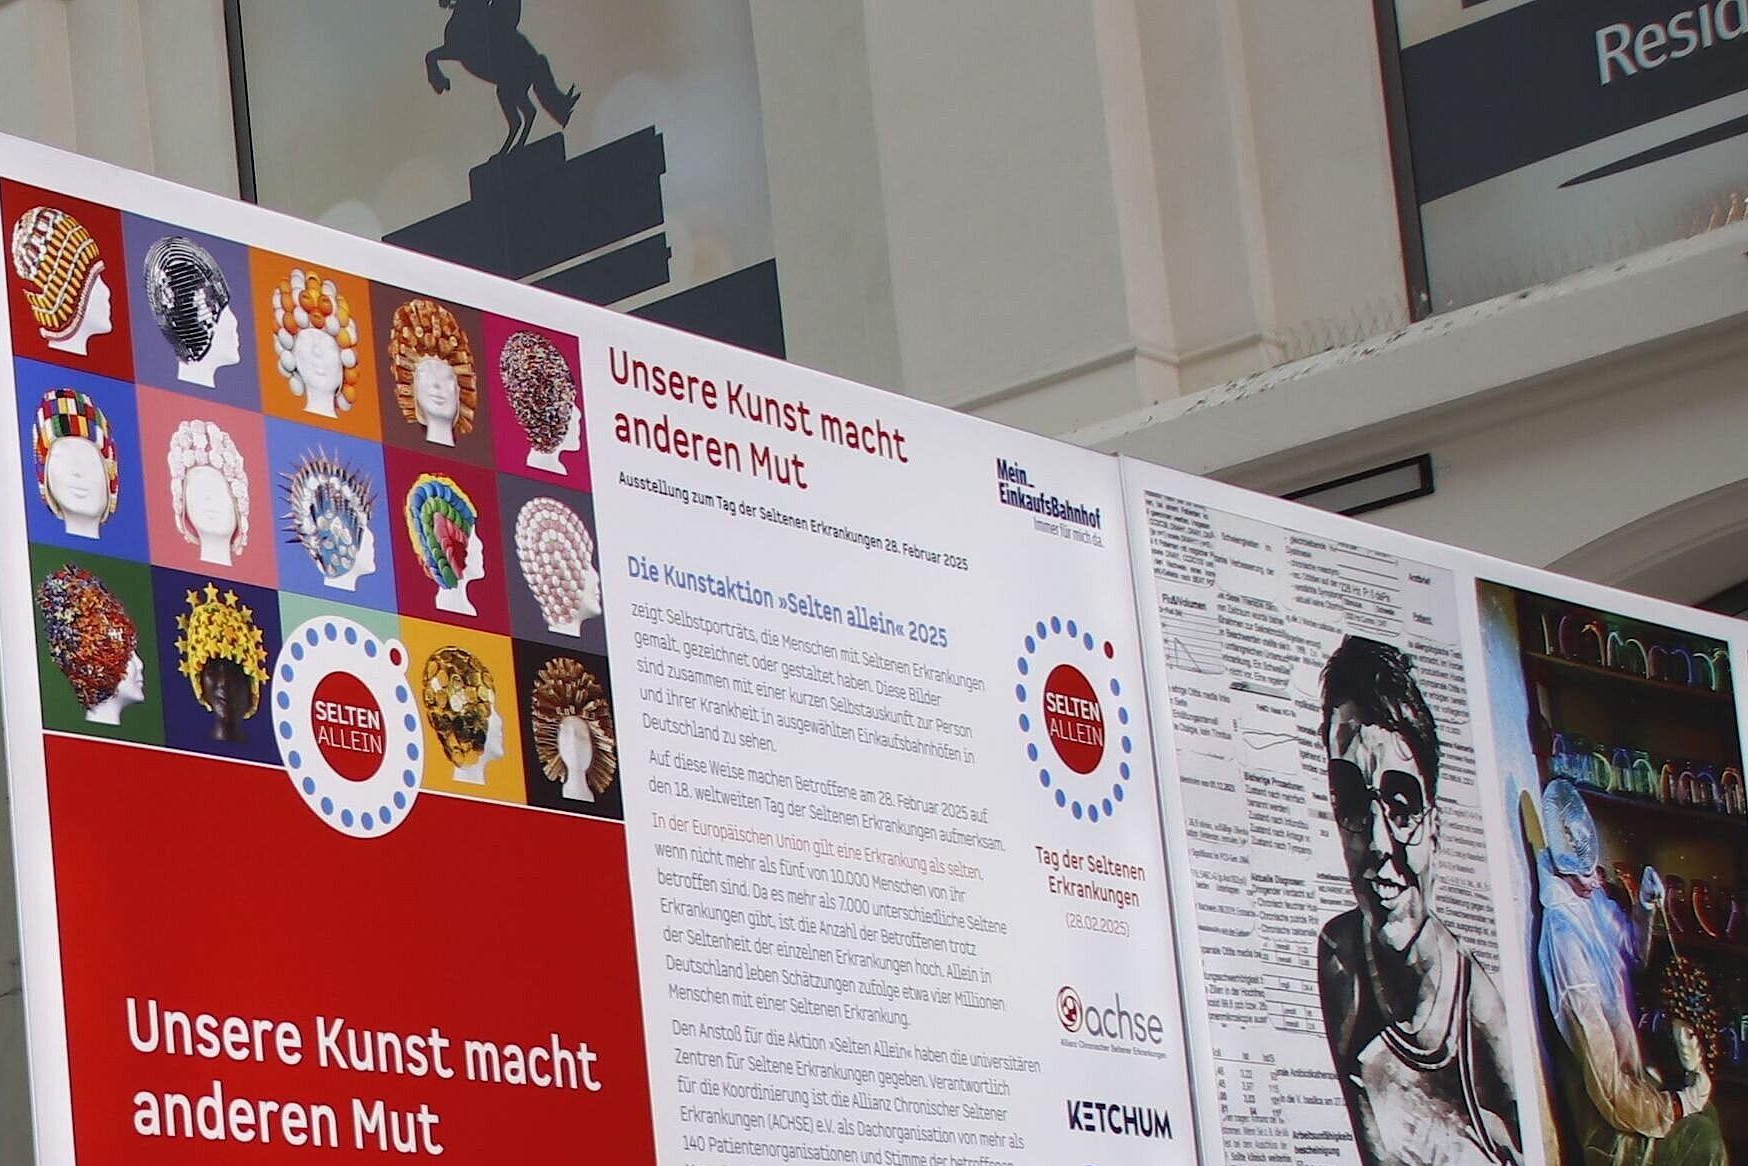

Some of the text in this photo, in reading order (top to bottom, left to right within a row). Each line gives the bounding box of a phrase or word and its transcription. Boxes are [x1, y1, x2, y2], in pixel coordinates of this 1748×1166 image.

[609, 346, 908, 463] Unsere Kunst macht
[614, 412, 807, 489] anderen Mut
[619, 471, 968, 570] Ausstellung zum Tag der Seltenen Erkrankungen 28. Februar 2025
[998, 482, 1101, 530] EinkaufsBahnhof
[627, 555, 947, 648] Die Kunstaktion »Selten allein« 2025
[631, 602, 984, 690] zeigt Selbstporträts, die Menschen mit Seltenen Erkrankungen
[315, 701, 380, 730] SELTEN
[1046, 692, 1101, 722] SELTEN
[318, 726, 383, 754] ALLEIN
[1050, 718, 1103, 747] ALLEIN
[1035, 846, 1146, 881] Tag der Seltenen
[1048, 875, 1140, 909] Erkrankungen
[1066, 912, 1130, 938] (28.02.2025)
[1086, 993, 1164, 1044] achse
[126, 997, 601, 1091] Unsere Kunst macht
[133, 1081, 443, 1155] anderen Mut
[1067, 1099, 1173, 1139] KETCHUM
